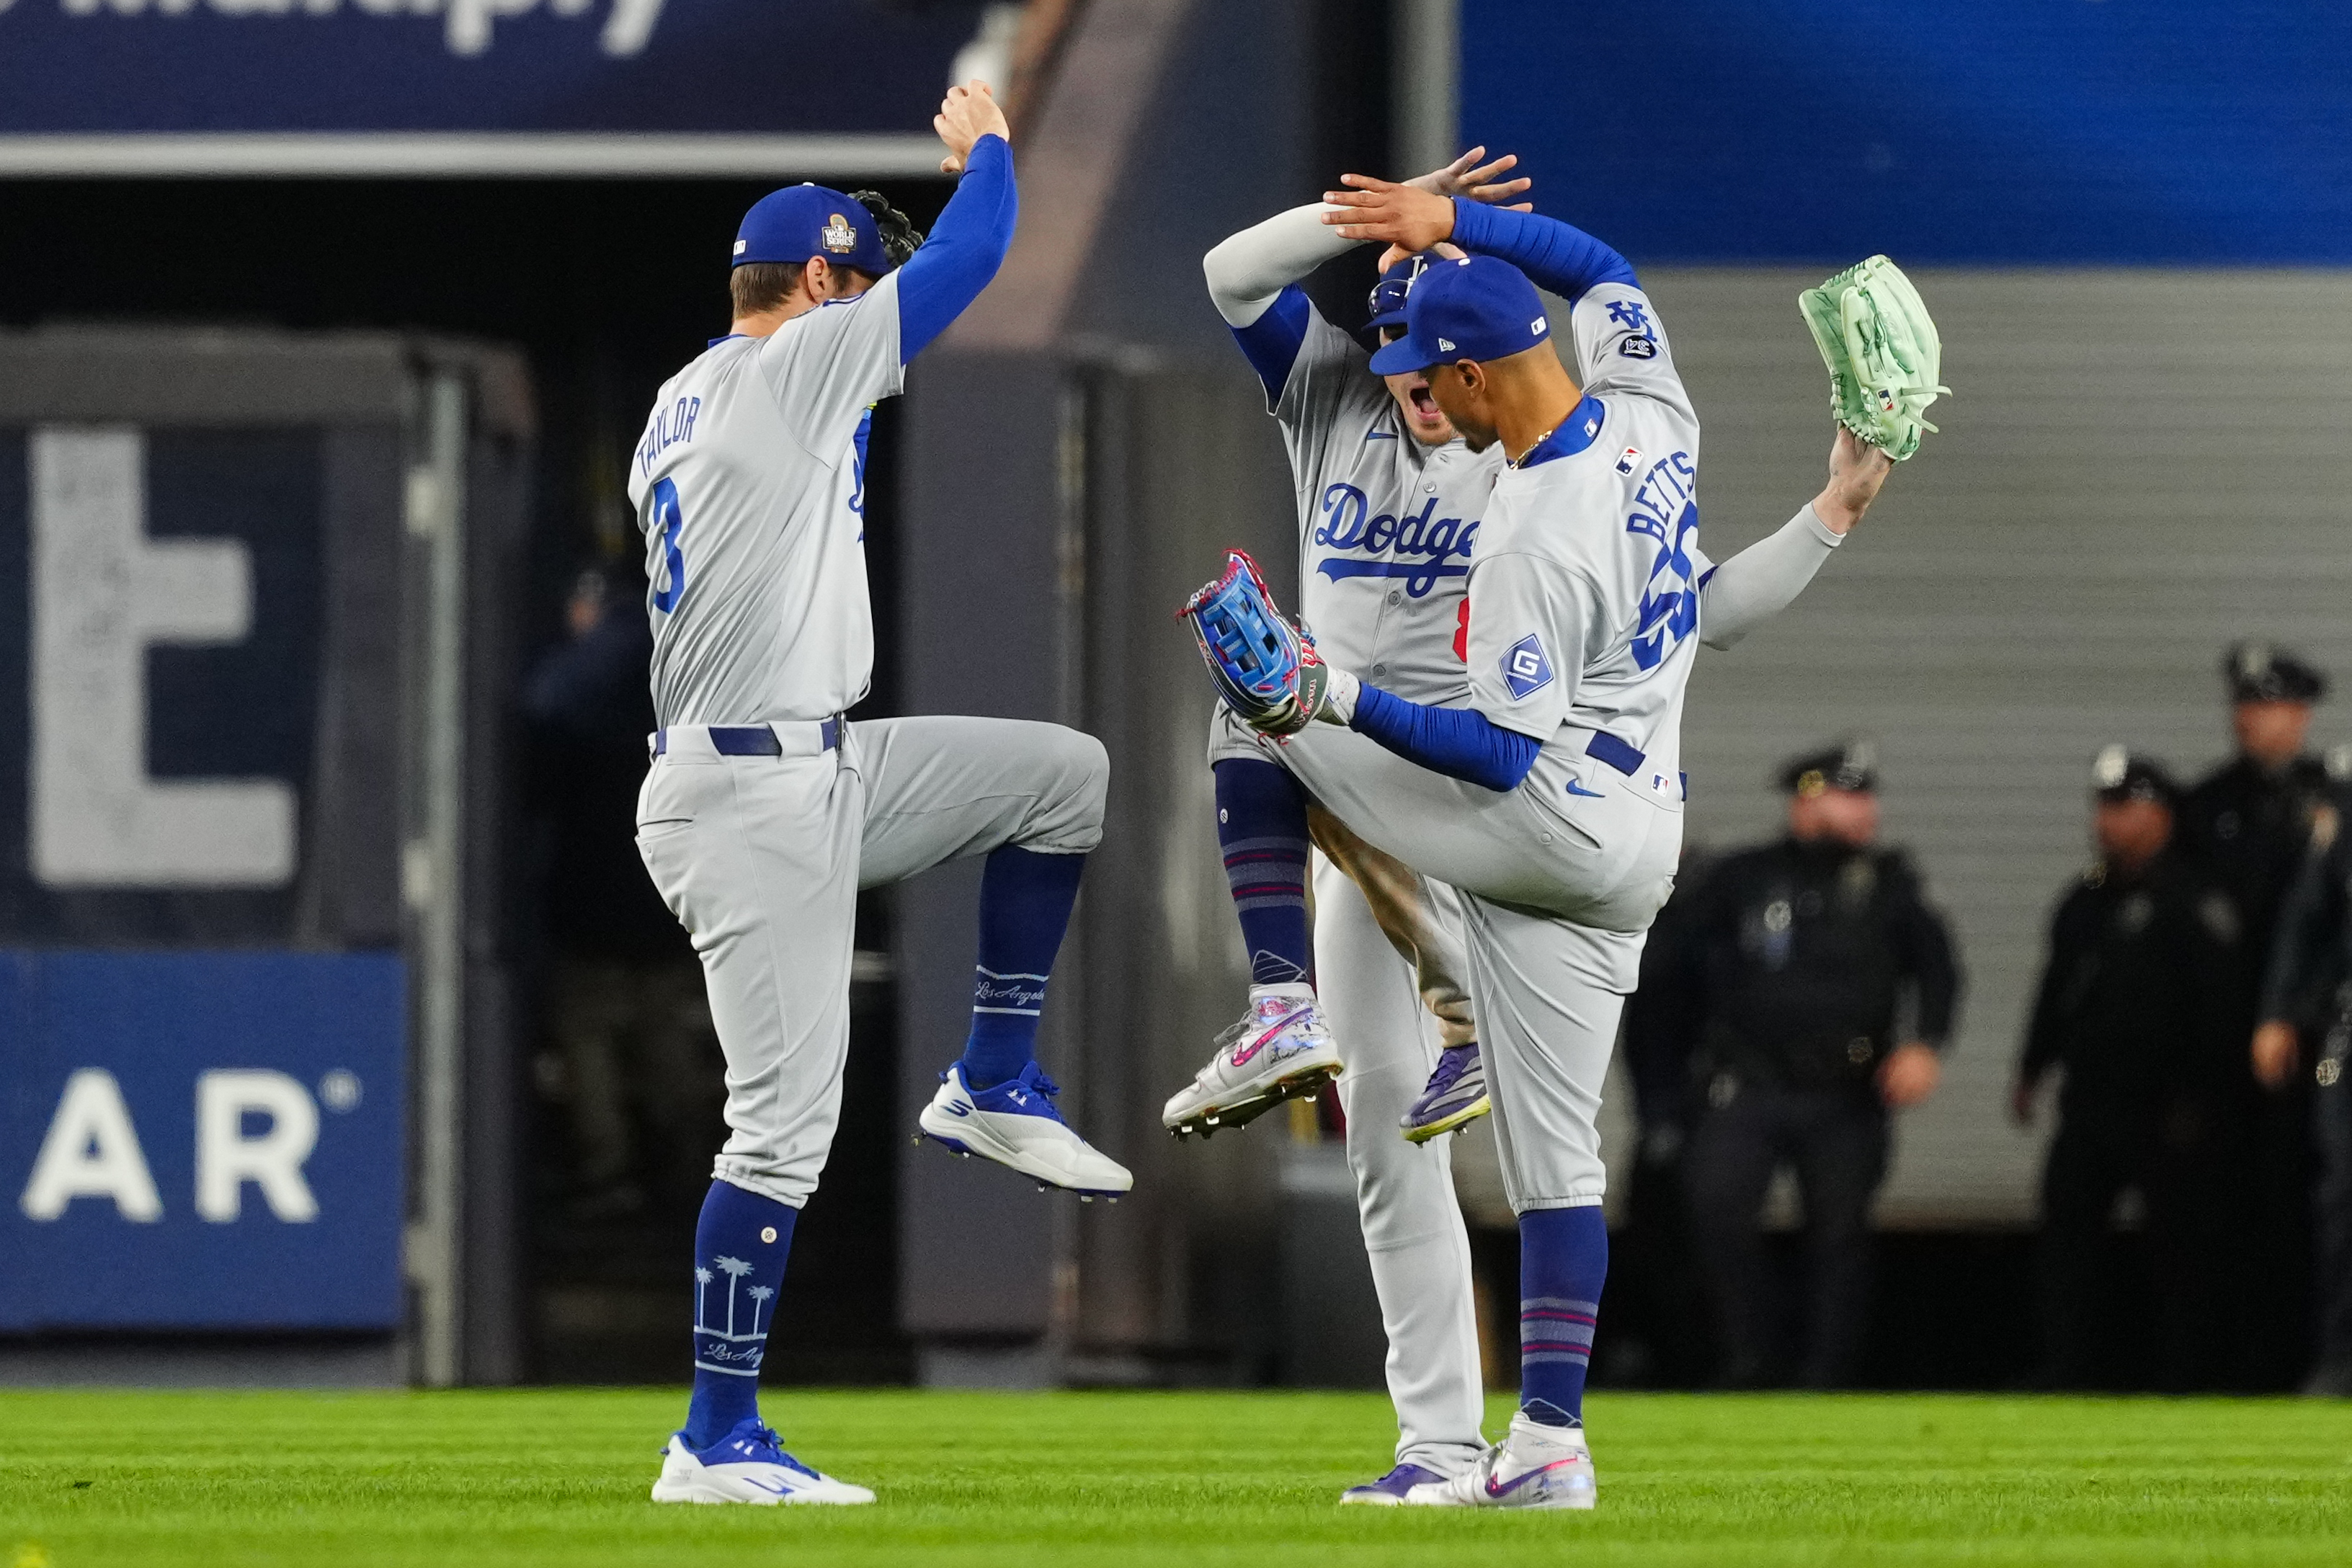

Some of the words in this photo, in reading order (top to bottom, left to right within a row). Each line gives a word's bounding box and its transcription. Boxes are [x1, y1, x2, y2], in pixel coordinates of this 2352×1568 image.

[824, 229, 855, 239] WORLD
[827, 237, 854, 246] SERIES
[1626, 339, 1650, 352] 34
[637, 396, 700, 480] TAYLOR
[1626, 450, 1695, 545] BETTS
[1513, 650, 1540, 676] G
[975, 981, 994, 999] Los
[704, 1343, 732, 1360] Los
